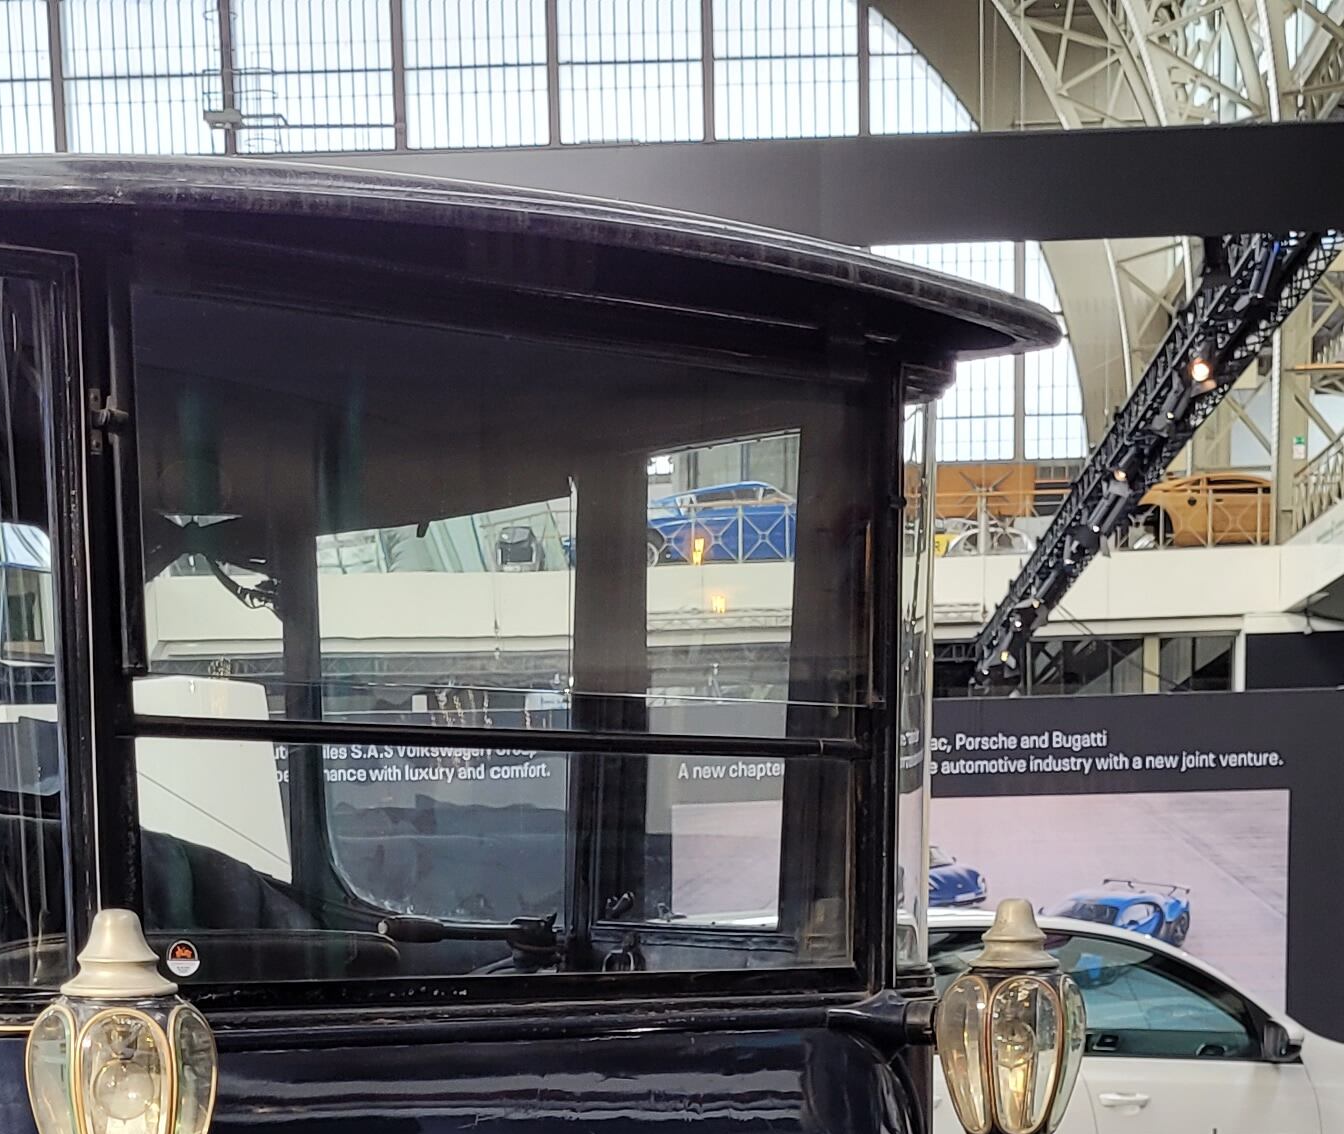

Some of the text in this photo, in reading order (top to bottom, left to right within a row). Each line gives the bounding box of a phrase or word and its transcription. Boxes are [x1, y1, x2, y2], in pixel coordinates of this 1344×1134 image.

[955, 731, 1017, 751] Porsche
[1020, 731, 1049, 749] and
[1052, 729, 1107, 752] Bugatti
[369, 765, 401, 781] with
[404, 764, 455, 784] luxury
[457, 763, 485, 780] and
[489, 762, 551, 780] comfort.
[677, 763, 690, 780] A
[692, 765, 727, 779] new
[941, 755, 1027, 775] automotive
[1029, 754, 1092, 776] industry
[1096, 752, 1130, 772] with
[1132, 757, 1143, 770] a
[1145, 755, 1179, 770] new
[1182, 750, 1216, 773] joint
[1219, 749, 1284, 768] venture.
